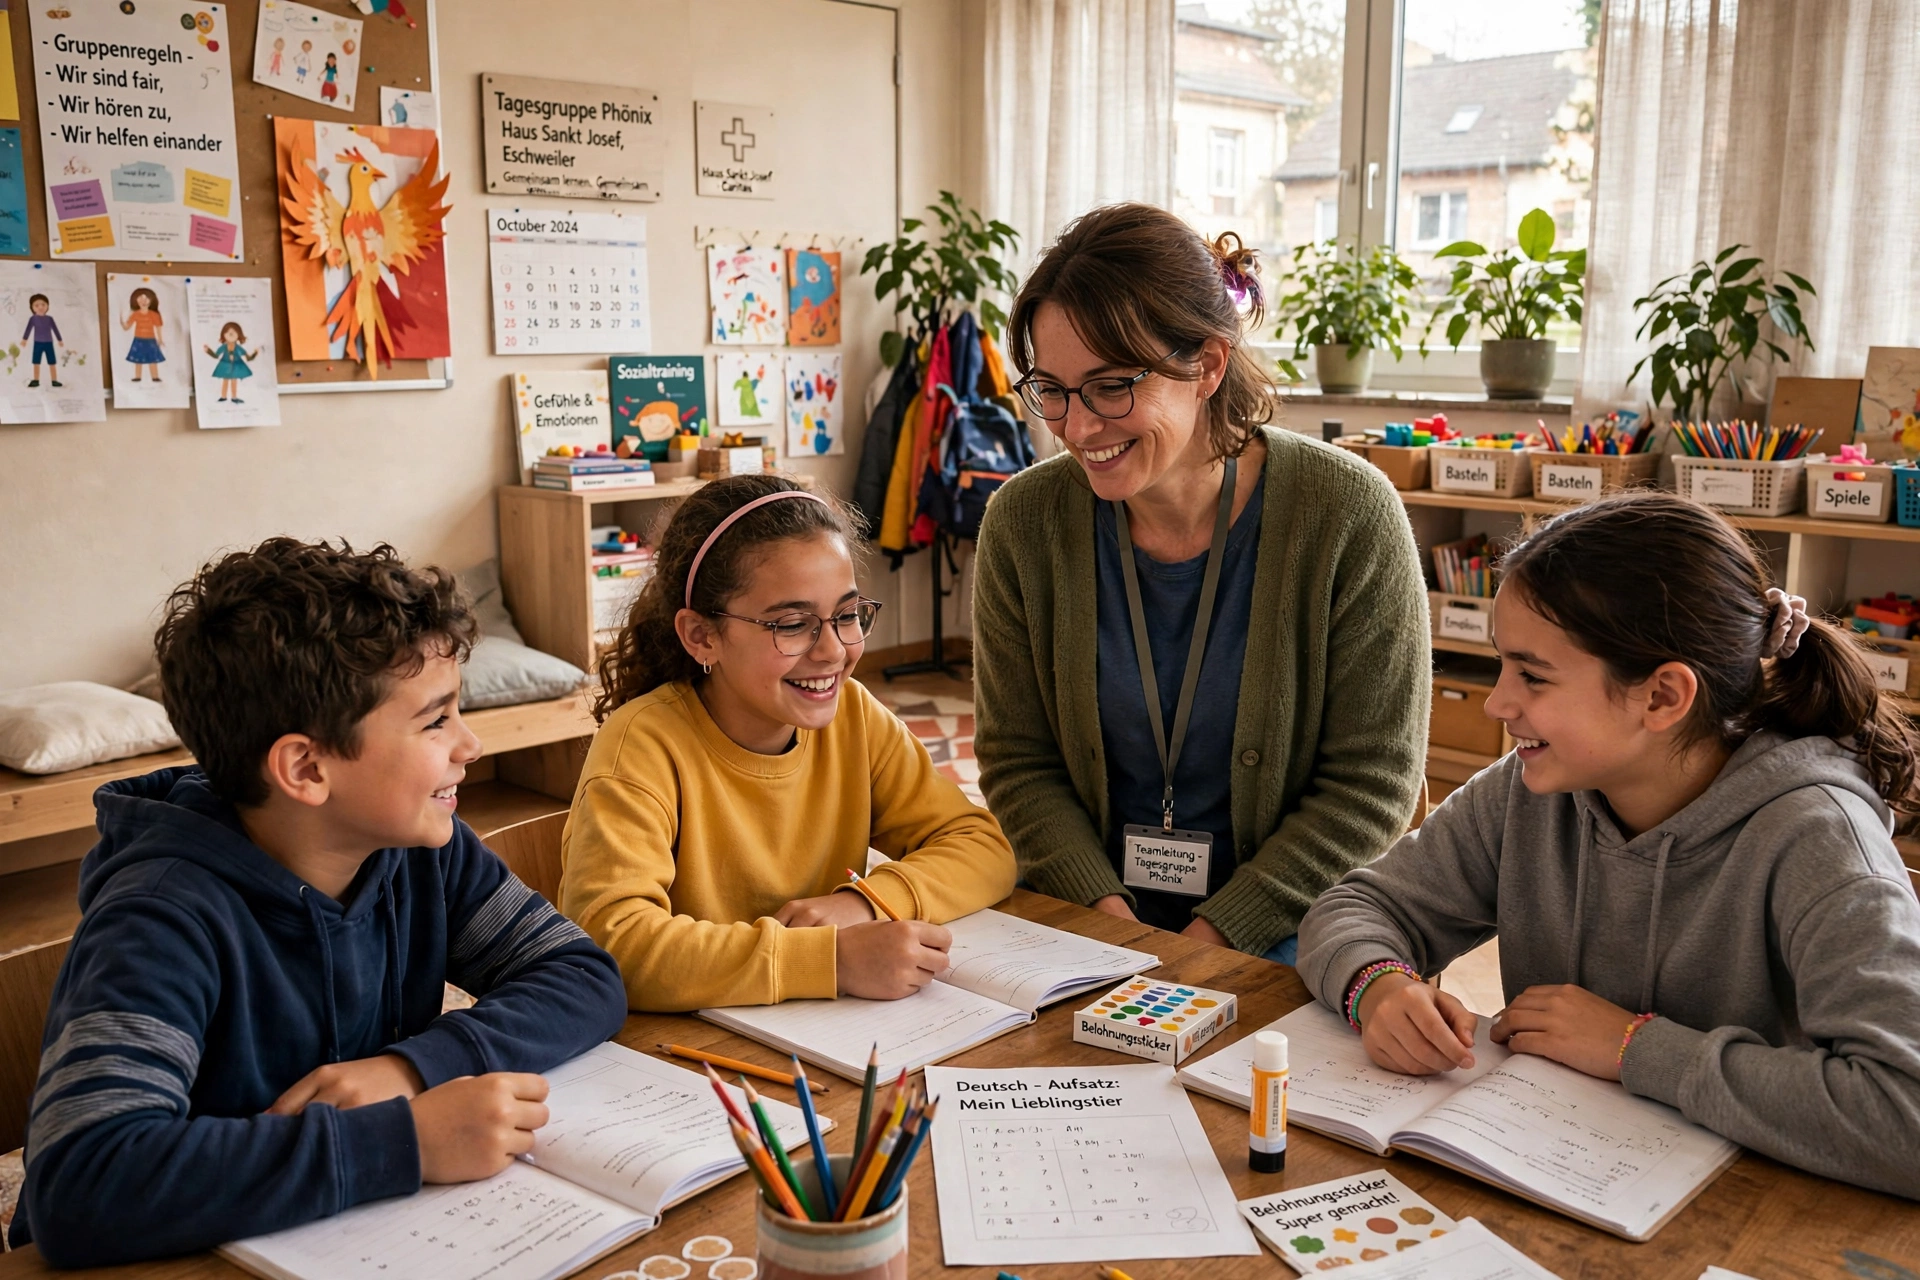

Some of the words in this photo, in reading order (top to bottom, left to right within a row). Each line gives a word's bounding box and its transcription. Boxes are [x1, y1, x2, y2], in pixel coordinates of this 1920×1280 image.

[54, 33, 182, 66] Gruppenregeln
[56, 64, 87, 84] Wir
[93, 68, 127, 88] sind
[133, 71, 164, 93] fair,
[59, 94, 89, 114] Wir
[95, 97, 143, 118] hören
[148, 106, 171, 123] zu,
[494, 91, 597, 123] Tagesgruppe
[602, 102, 652, 125] Phönix
[61, 124, 91, 144] Wir
[96, 126, 148, 147] helfen
[154, 132, 222, 151] einander
[502, 120, 538, 140] Haus
[542, 125, 582, 144] Sankt
[587, 129, 624, 151] Josef,
[503, 146, 575, 167] Eschweiler
[551, 221, 578, 233] 2024
[505, 282, 511, 292] 9
[569, 284, 578, 293] 12
[617, 363, 695, 382] Sozialtraining
[534, 394, 580, 408] Gefühle
[584, 393, 593, 407] &
[536, 413, 598, 427] Emotionen
[1446, 466, 1488, 482] Basteln
[1548, 473, 1593, 489] Basteln
[1825, 488, 1871, 507] Spiele
[1134, 843, 1195, 862] Teamleitung
[1081, 1020, 1171, 1051] Belohnungssticker
[956, 1080, 1028, 1092] Deutsch
[1048, 1078, 1120, 1090] Aufsatz:
[960, 1098, 1006, 1110] Mein
[1011, 1095, 1123, 1111] Lieblingstier
[1250, 1178, 1388, 1218] Belohnungssticker
[1276, 1212, 1324, 1230] Super
[1327, 1192, 1400, 1221] gemacht!
